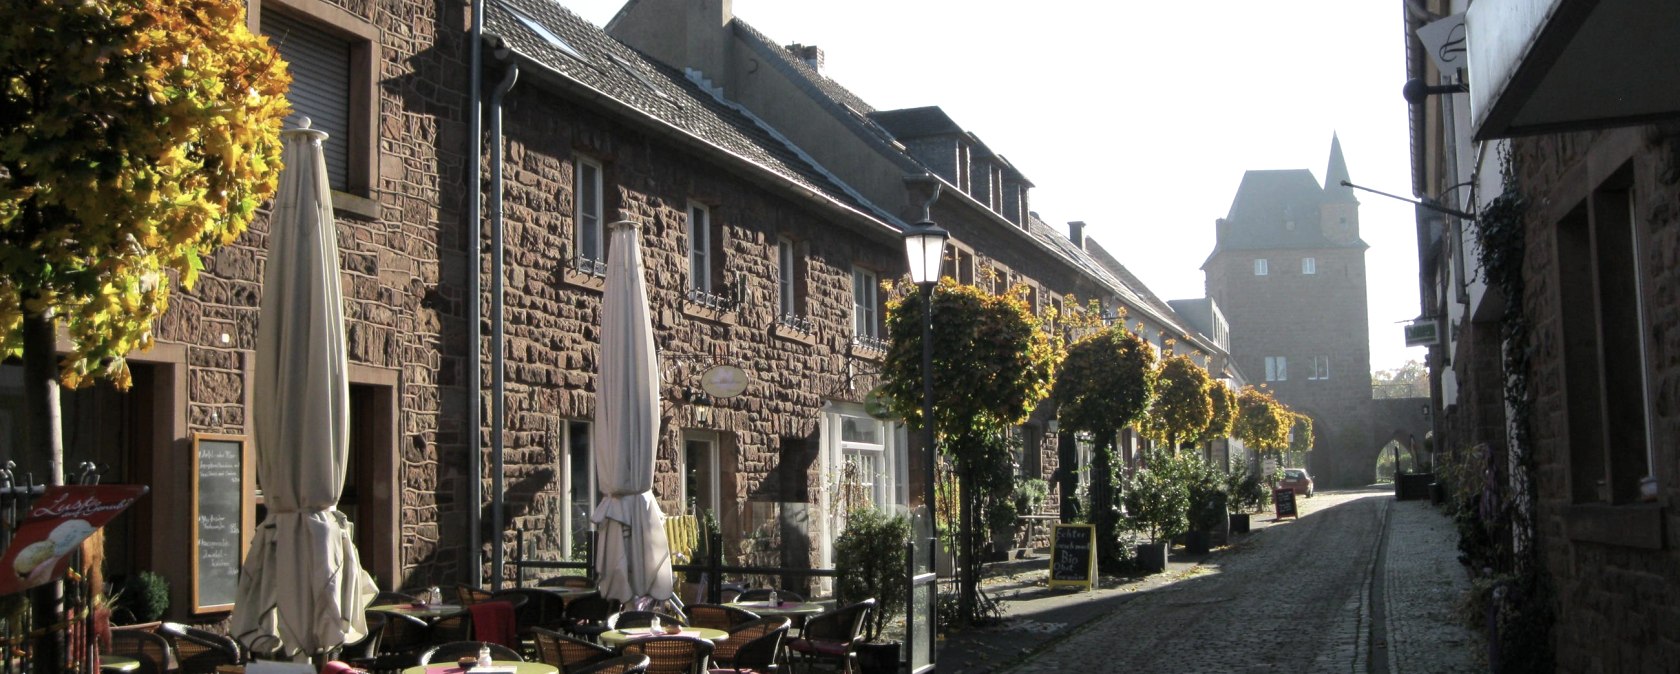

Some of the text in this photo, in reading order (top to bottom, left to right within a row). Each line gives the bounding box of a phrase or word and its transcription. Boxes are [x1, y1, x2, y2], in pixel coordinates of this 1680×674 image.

[33, 493, 94, 517] Lust
[1061, 550, 1078, 564] Bio
[1053, 562, 1074, 571] Obst
